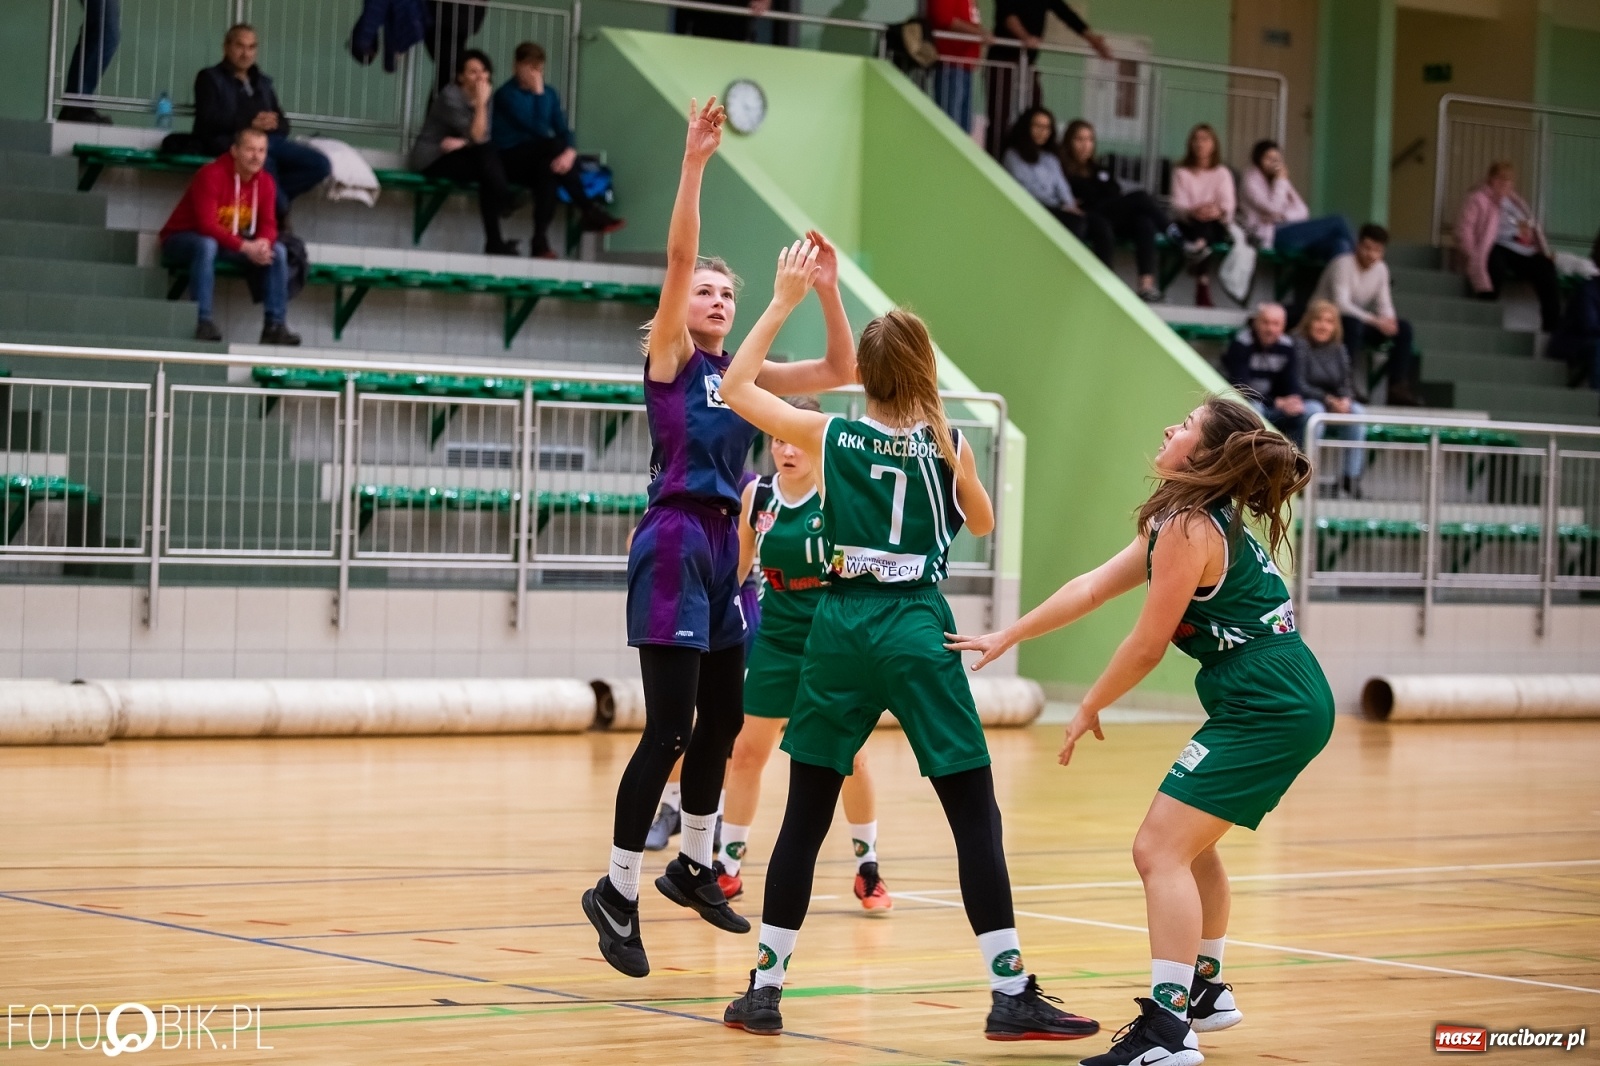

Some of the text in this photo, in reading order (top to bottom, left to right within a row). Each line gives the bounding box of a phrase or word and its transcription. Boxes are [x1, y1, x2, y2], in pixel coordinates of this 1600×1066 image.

[838, 431, 866, 451] RKK
[870, 463, 907, 546] 7
[805, 536, 825, 564] 11
[846, 560, 920, 577] WAGTECH
